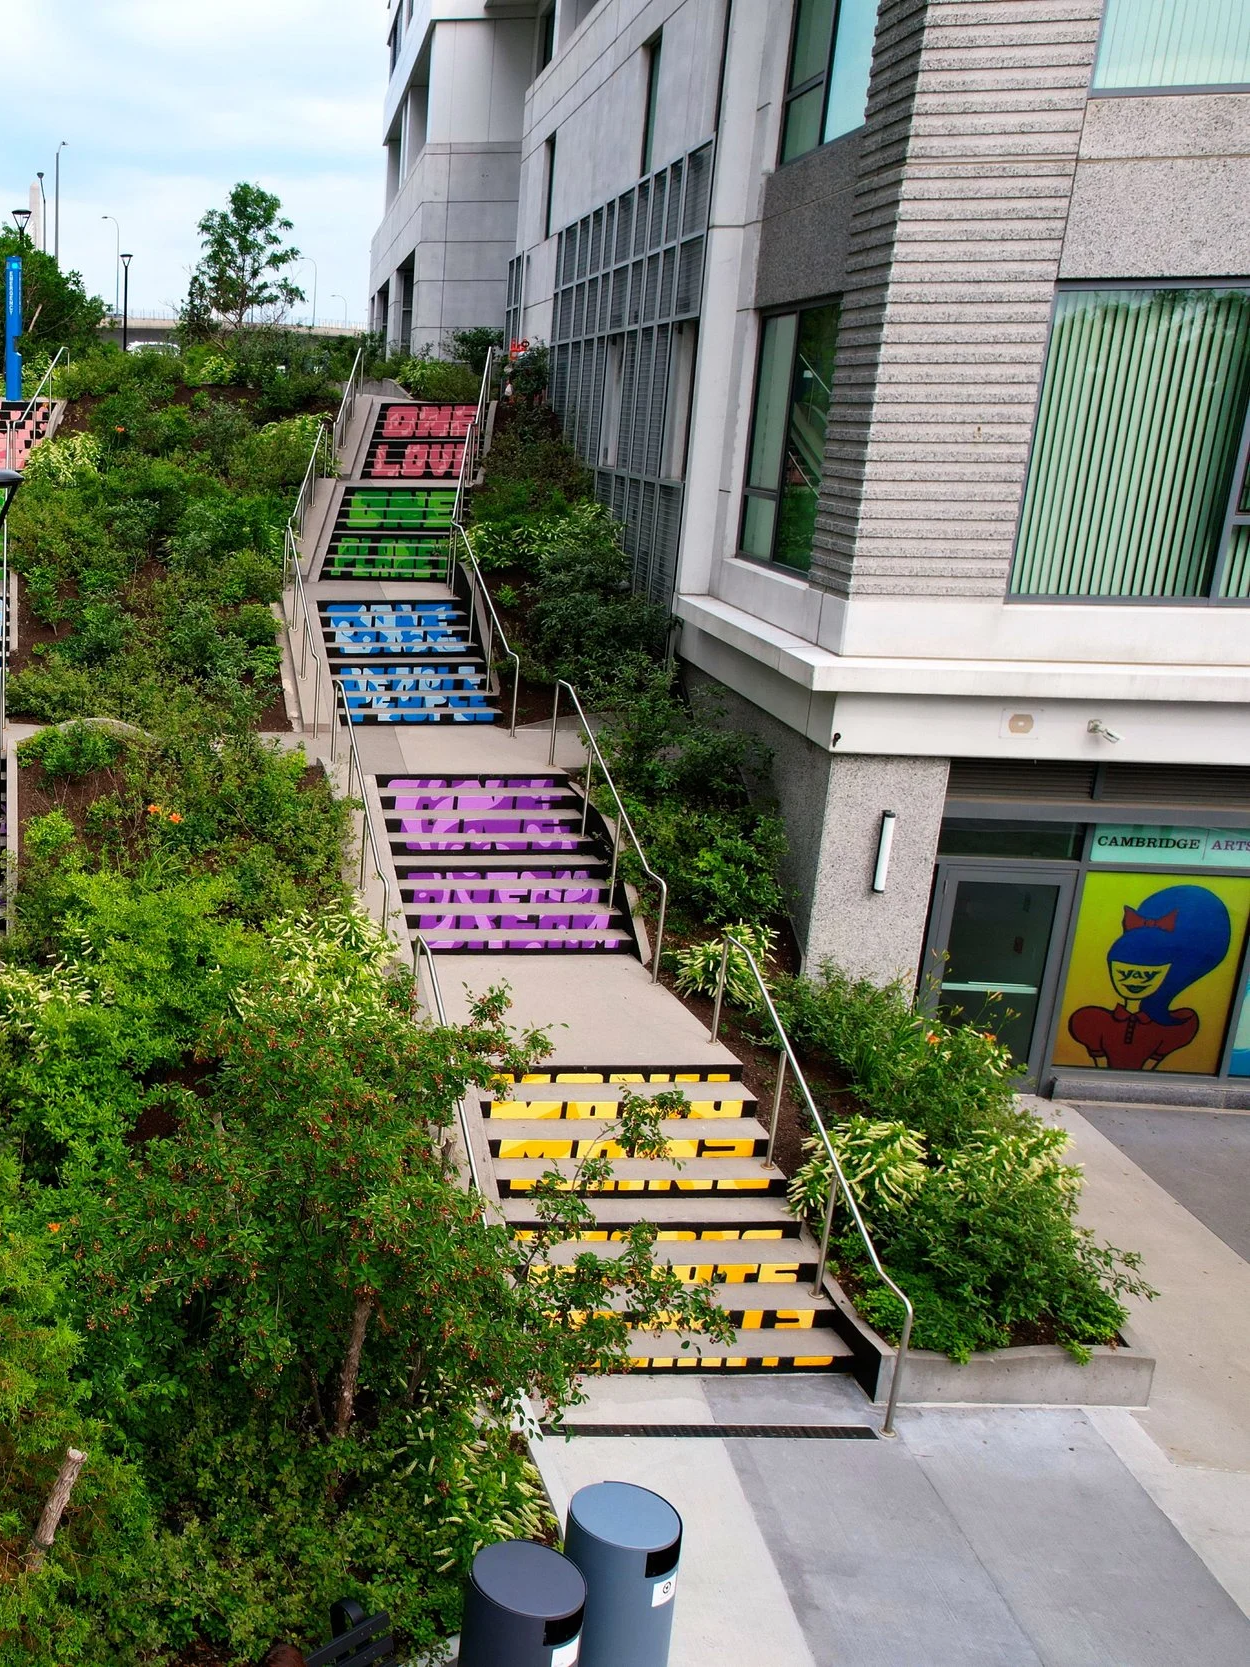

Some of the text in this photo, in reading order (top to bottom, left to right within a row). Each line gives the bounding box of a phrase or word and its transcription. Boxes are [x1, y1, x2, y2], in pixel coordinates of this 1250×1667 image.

[382, 405, 479, 437] ONE
[346, 491, 459, 528] ONE
[326, 604, 467, 654] ONE
[340, 666, 495, 722] PEOPLE
[387, 779, 578, 850] ONE
[1097, 835, 1201, 850] CAMBRIDGE
[407, 870, 620, 949] DREAM
